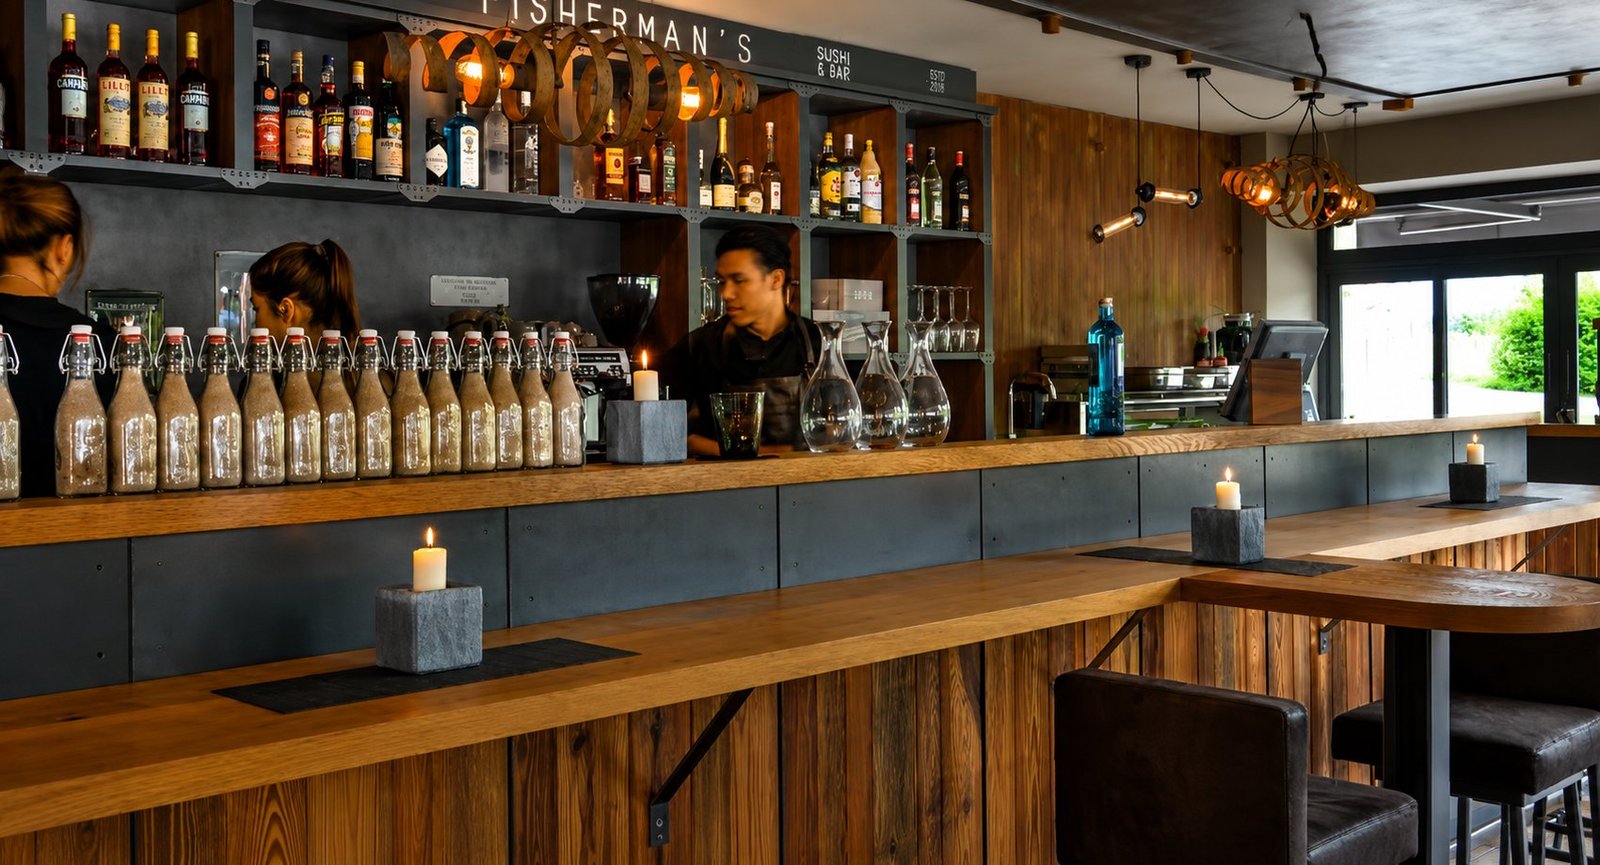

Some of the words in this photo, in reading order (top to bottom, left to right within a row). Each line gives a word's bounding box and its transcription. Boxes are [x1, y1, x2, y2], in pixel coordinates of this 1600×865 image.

[817, 46, 850, 65] SUSHI
[817, 62, 825, 77] &
[829, 63, 851, 81] BAR
